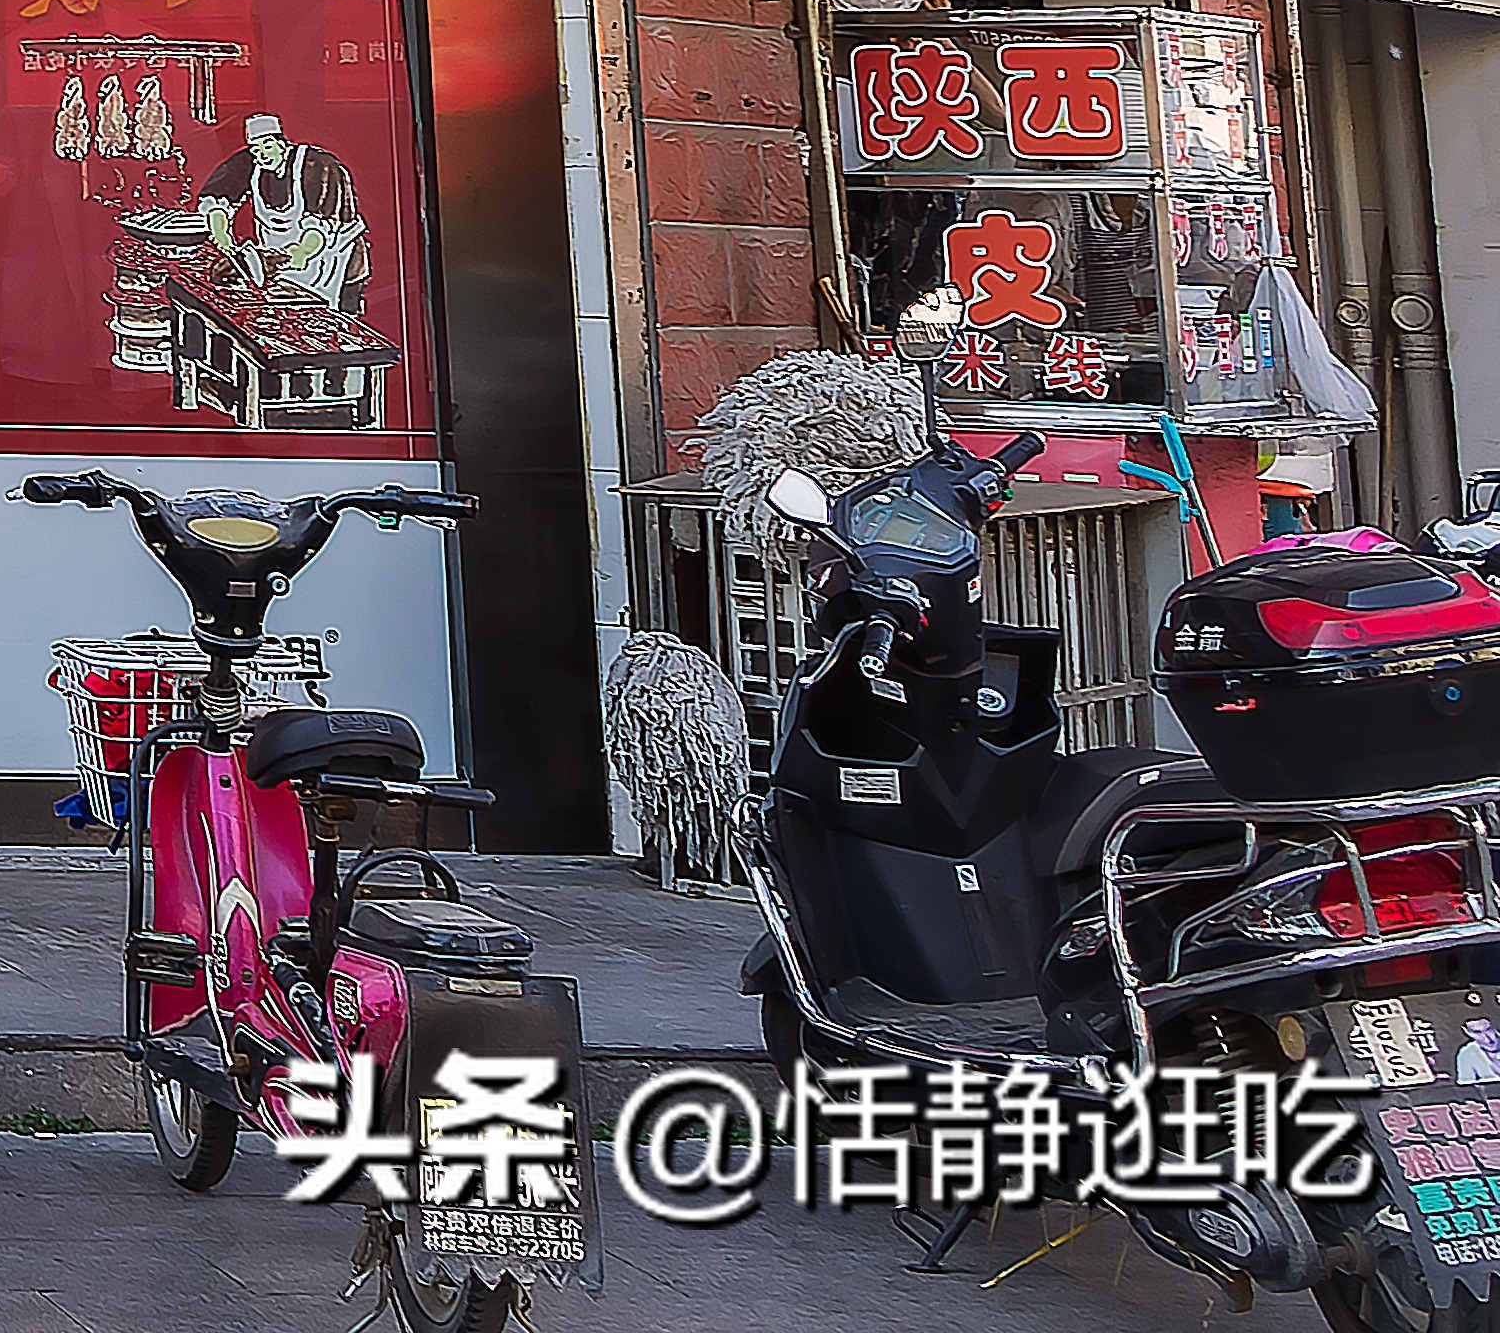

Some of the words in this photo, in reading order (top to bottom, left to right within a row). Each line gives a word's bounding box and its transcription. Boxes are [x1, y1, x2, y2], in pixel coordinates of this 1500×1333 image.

[851, 41, 1128, 161] 陕西
[941, 209, 1068, 332] 皮
[1378, 1098, 1500, 1144] 史可法
